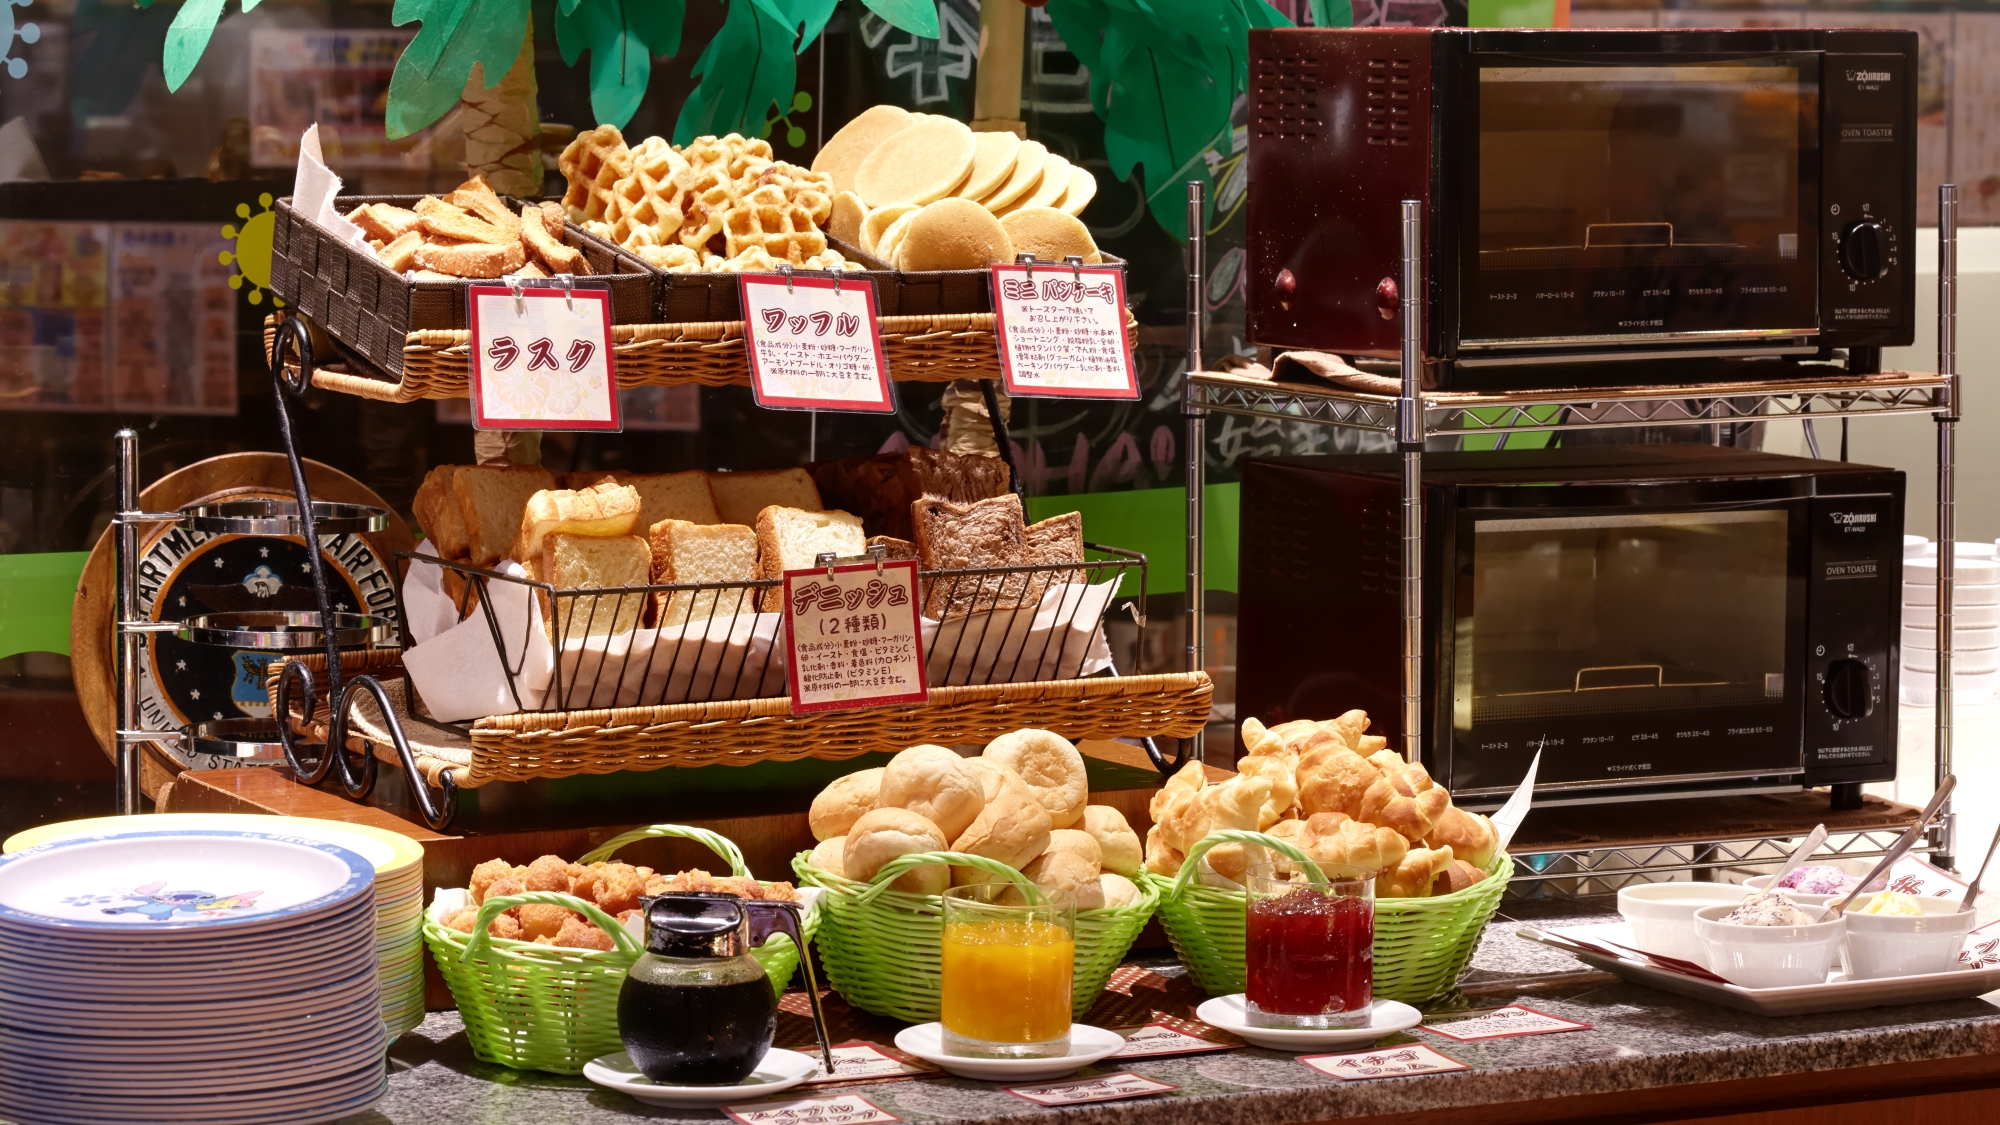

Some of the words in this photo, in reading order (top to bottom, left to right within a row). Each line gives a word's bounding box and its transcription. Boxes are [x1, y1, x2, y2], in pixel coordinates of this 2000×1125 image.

[1856, 69, 1890, 84] ZOJIRUSHI
[1841, 129, 1861, 137] OVEN
[1862, 128, 1893, 137] TOASTER
[1003, 279, 1039, 300] ミニ
[1042, 278, 1114, 304] パンケーキ
[761, 307, 859, 337] ワッフル
[488, 336, 595, 373] ラスク
[1842, 512, 1877, 526] ZOJIRUSHI
[325, 533, 374, 574] AIR
[1826, 567, 1845, 575] OVEN
[1847, 565, 1877, 574] TOASTER
[793, 579, 908, 615] デニッシュ
[819, 613, 887, 636] (2種類)
